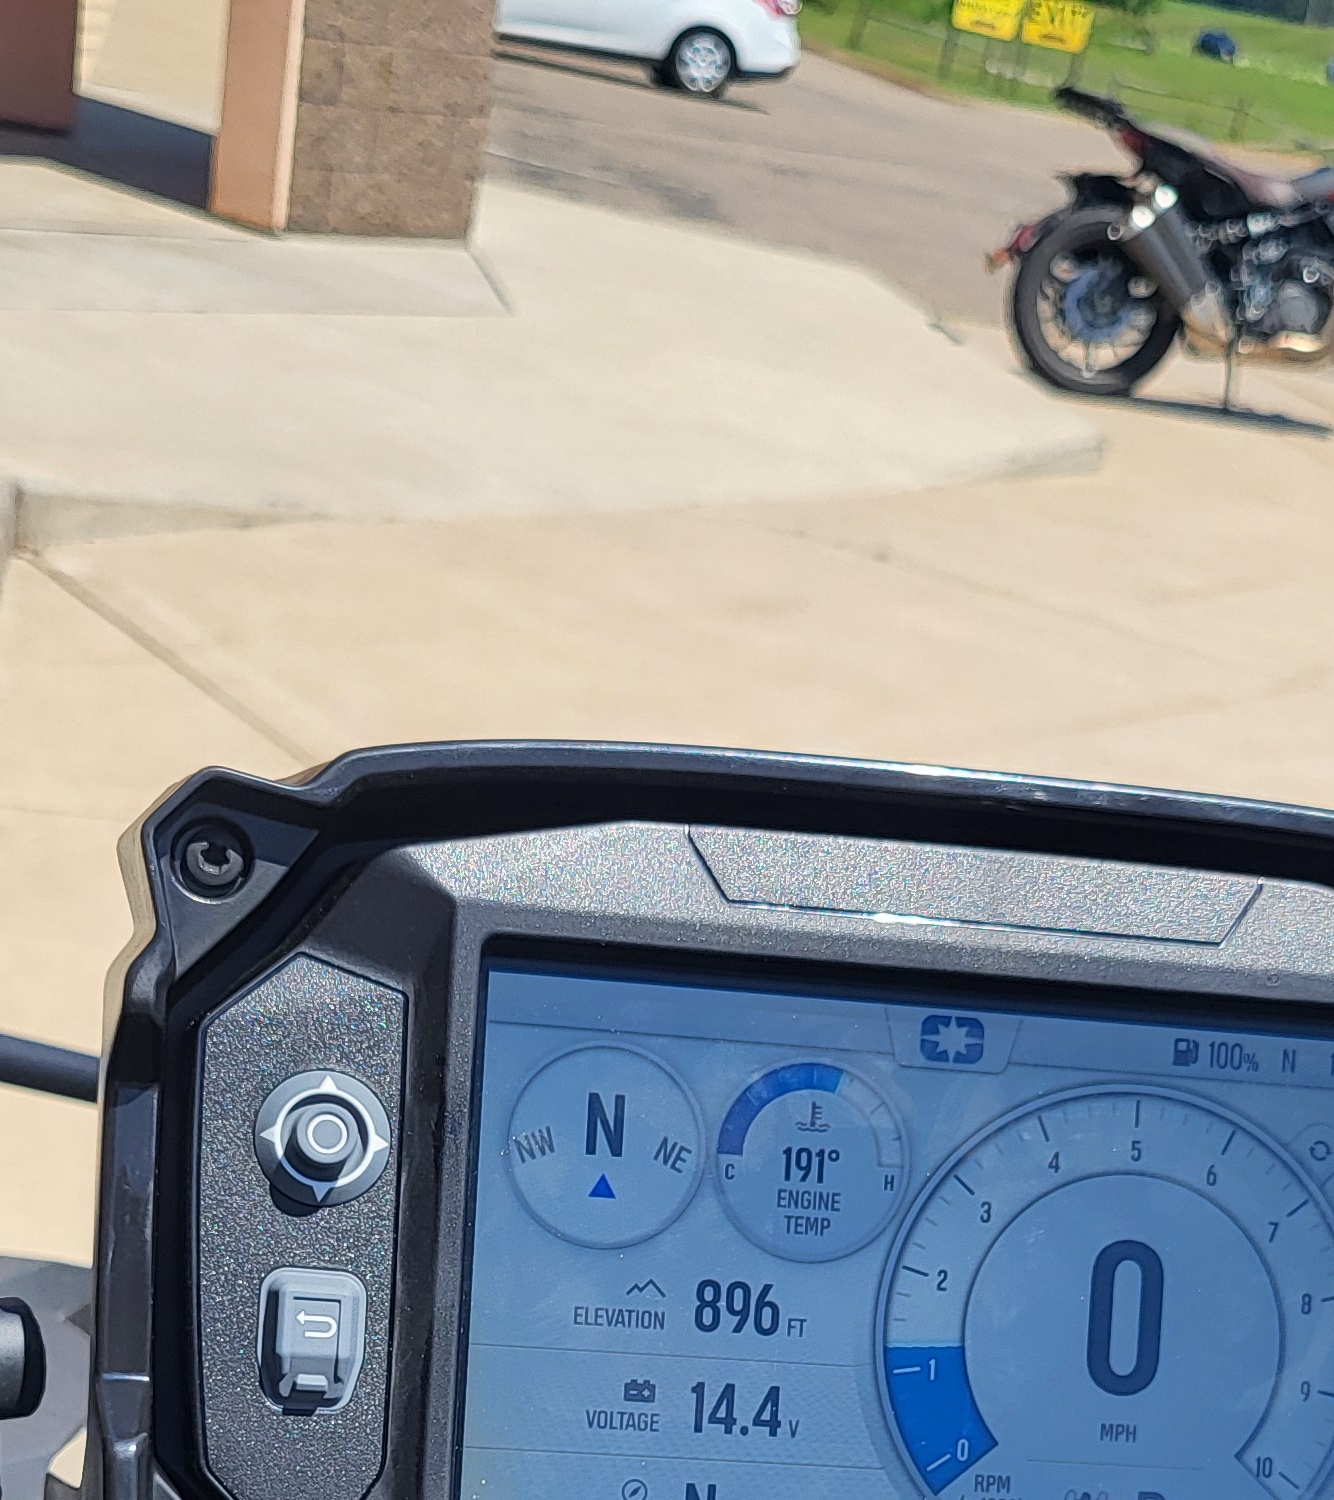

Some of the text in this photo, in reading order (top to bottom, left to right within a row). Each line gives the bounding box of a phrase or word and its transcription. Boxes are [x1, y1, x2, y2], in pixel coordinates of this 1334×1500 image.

[1208, 1041, 1258, 1073] 100%
[1282, 1050, 1297, 1074] N
[585, 1092, 627, 1158] N
[514, 1126, 555, 1164] NW
[653, 1136, 692, 1174] NE
[1131, 1142, 1142, 1162] 5
[724, 1163, 736, 1180] C
[1048, 1152, 1059, 1173] 4
[884, 1175, 895, 1192] H
[1206, 1166, 1217, 1186] 6
[777, 1189, 841, 1213] ENGINE
[980, 1203, 991, 1223] 3
[784, 1216, 832, 1237] TEMP
[1268, 1222, 1279, 1243] 7
[936, 1270, 948, 1291] 2
[573, 1279, 807, 1338] ELEVATION 896 FT
[1301, 1294, 1312, 1315] 8
[1087, 1240, 1164, 1396] 0
[927, 1359, 936, 1381] 1
[1300, 1381, 1311, 1401] 9
[586, 1381, 799, 1438] VOLTAGE 14.4 V
[1100, 1423, 1137, 1443] MPH
[956, 1440, 969, 1461] 0
[1255, 1457, 1274, 1479] 10
[974, 1474, 1011, 1494] RPM
